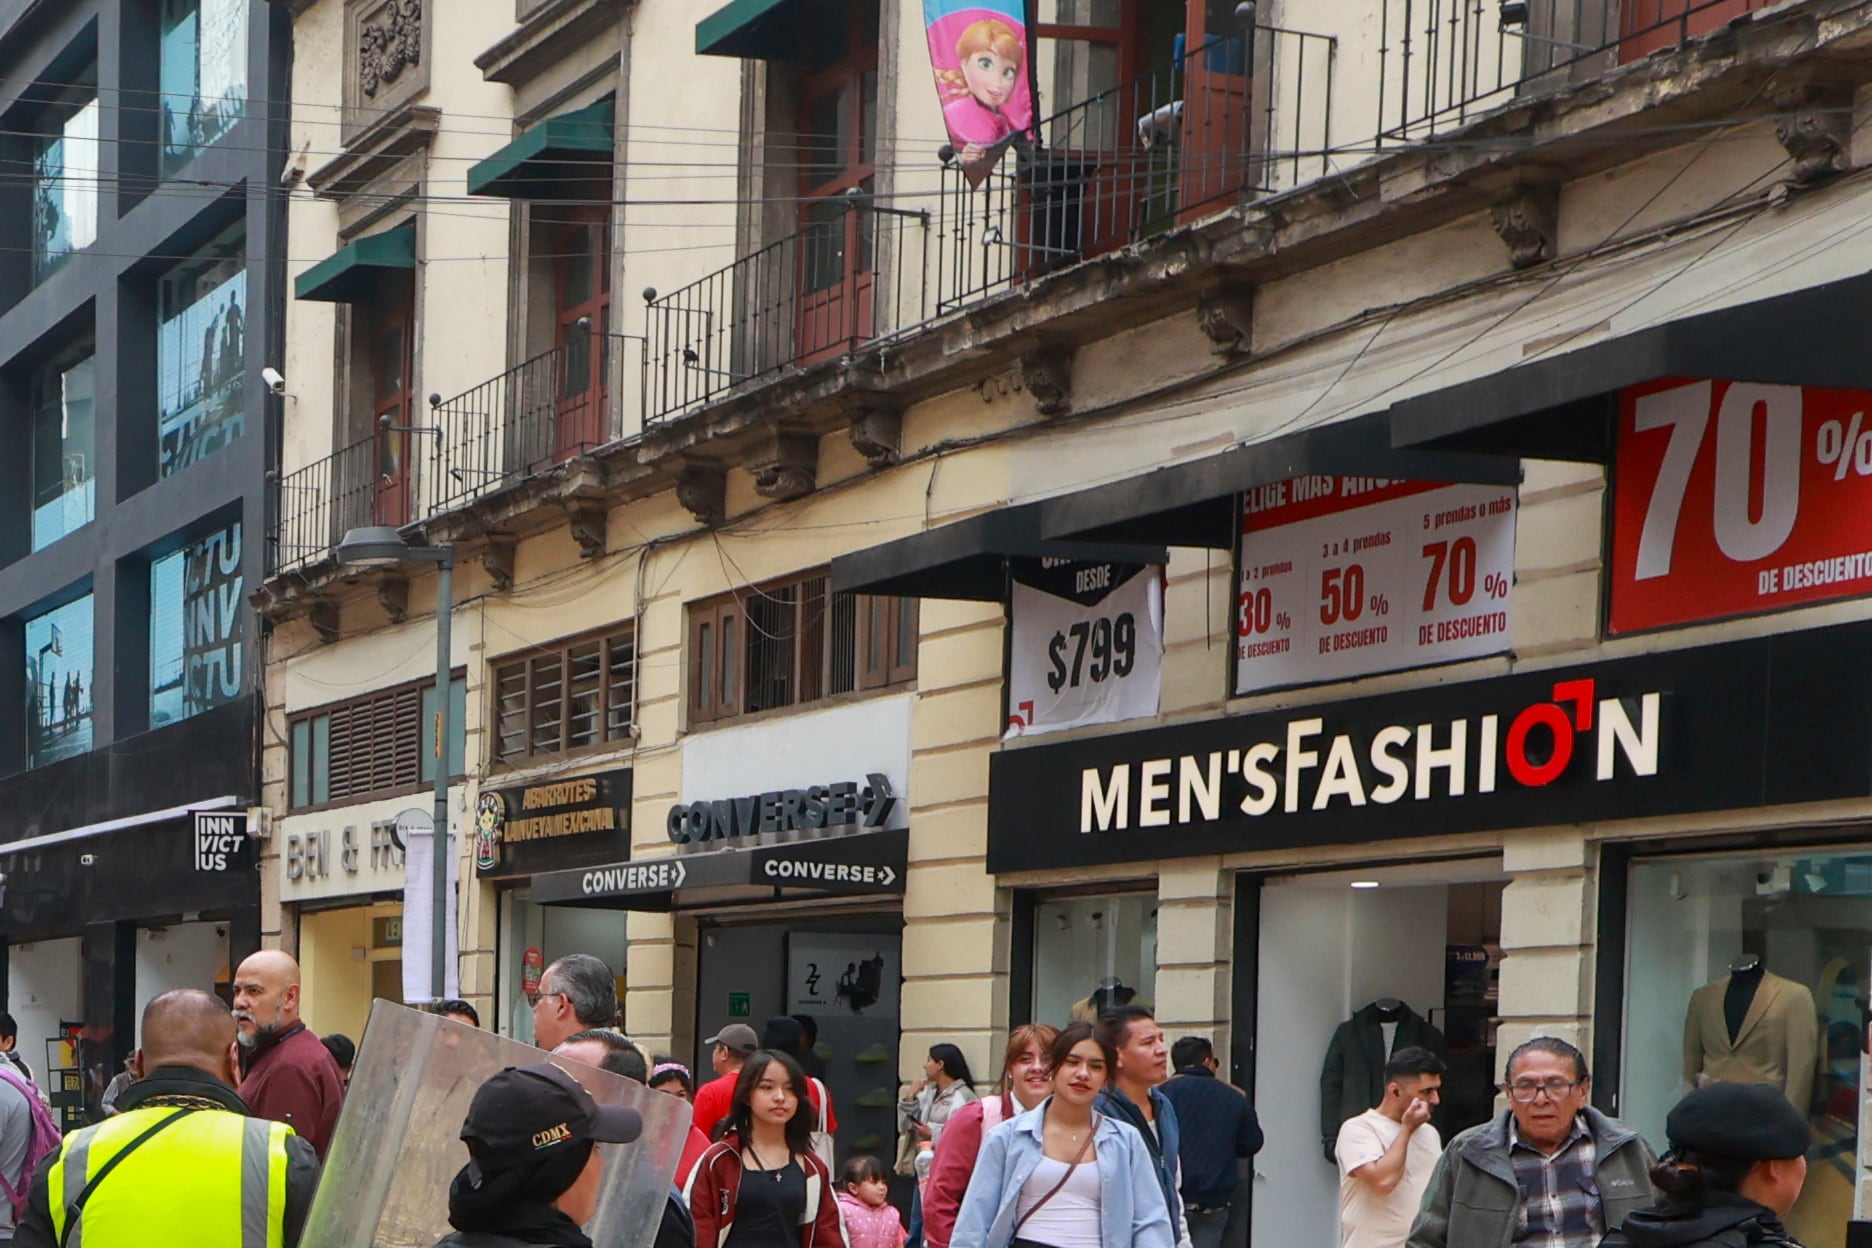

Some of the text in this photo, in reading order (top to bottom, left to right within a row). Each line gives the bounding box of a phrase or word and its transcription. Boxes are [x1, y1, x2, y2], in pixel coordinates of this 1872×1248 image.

[1635, 379, 1803, 581] 70
[1423, 496, 1512, 530] 5 prendas o más
[1322, 531, 1391, 559] 3 a 4 prendas
[1076, 564, 1111, 593] DESDE
[1254, 567, 1259, 579] 2
[1262, 560, 1292, 580] prendas
[1422, 536, 1508, 612] 70 %
[1758, 552, 1872, 595] DE DESCUENTO
[1320, 564, 1388, 625] 50 %
[1238, 587, 1291, 637] 30 %
[1319, 626, 1388, 655] DE DESCUENTO
[1419, 611, 1506, 645] DE DESCUENTO
[1047, 612, 1136, 695] $799
[1247, 638, 1291, 658] DESCUENTO
[522, 778, 597, 811] ABARROTES
[200, 818, 234, 835] INN
[667, 782, 858, 844] CONVERSE
[200, 835, 245, 853] VICT
[287, 830, 330, 880] BEN
[342, 825, 359, 873] &
[200, 853, 227, 871] US
[764, 860, 875, 883] CONVERSE
[583, 865, 670, 894] CONVERSE
[532, 1122, 571, 1147] CDMX
